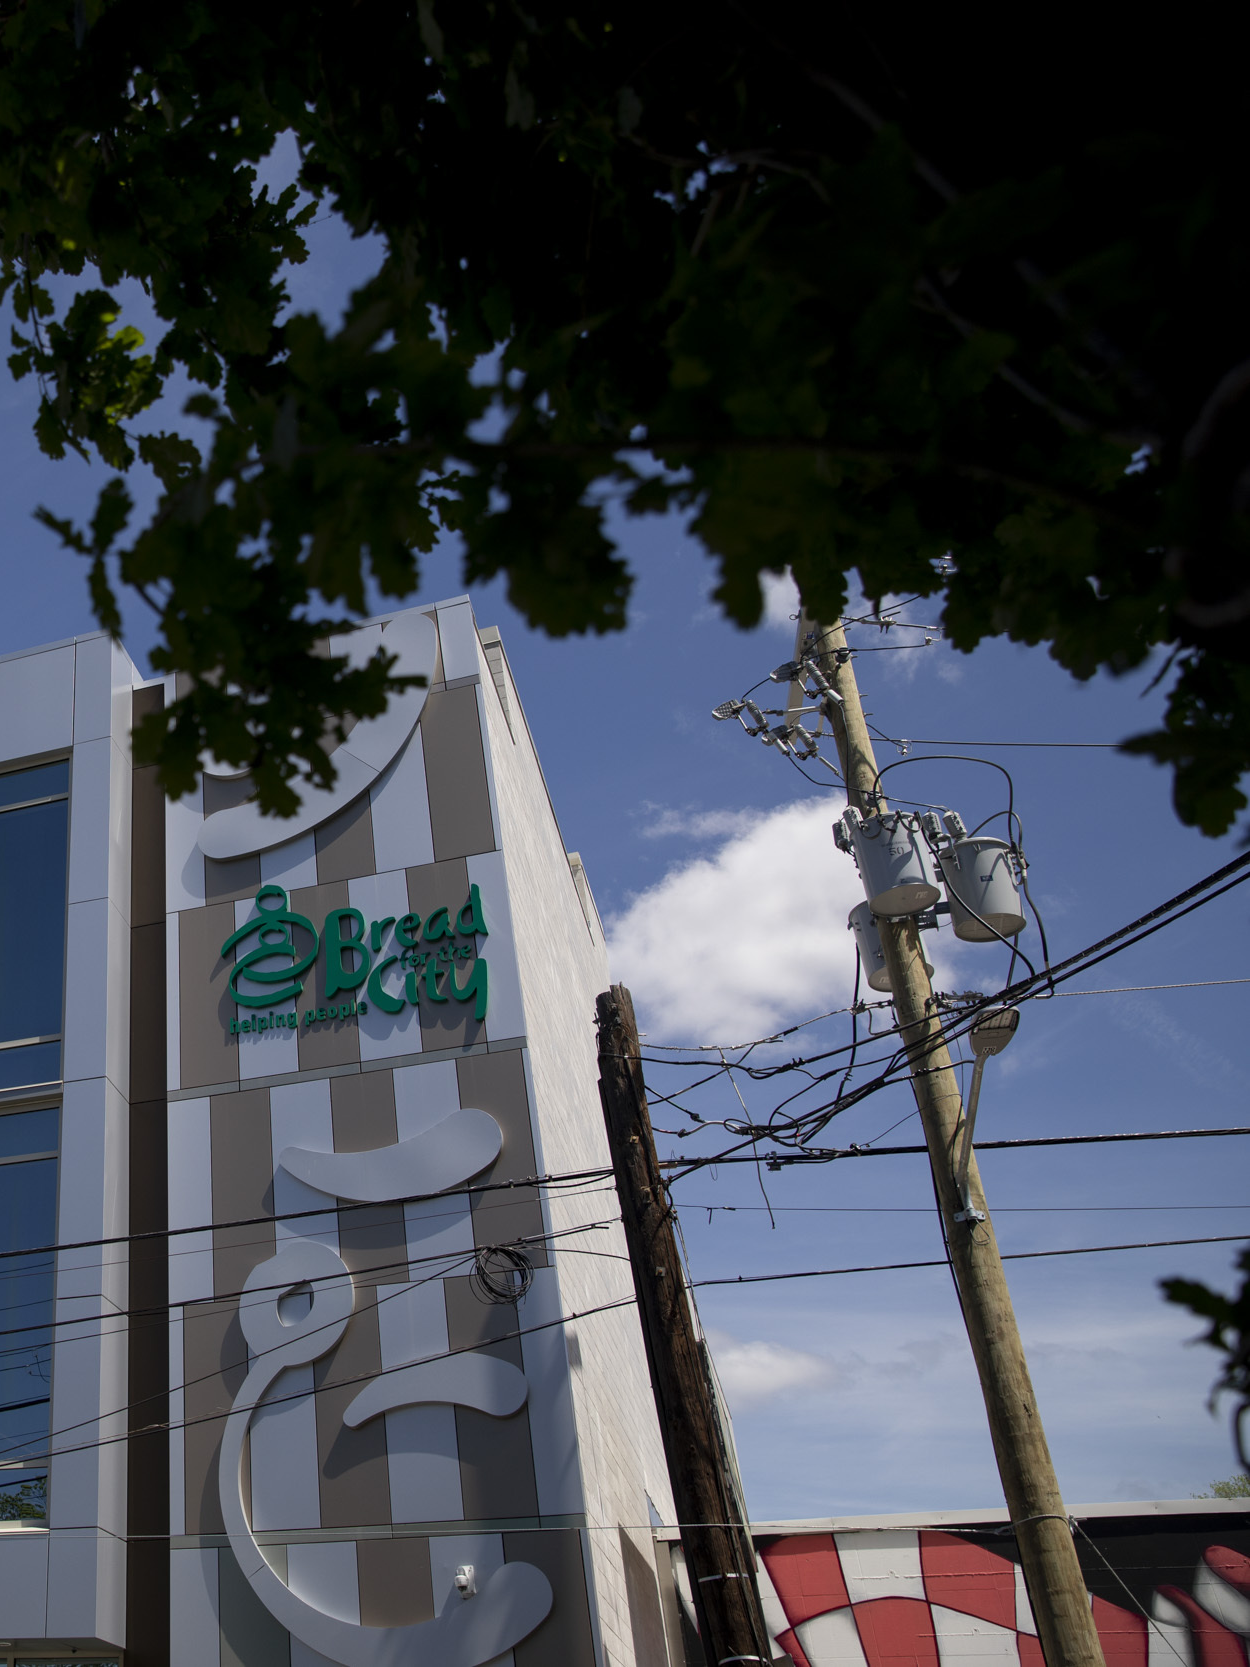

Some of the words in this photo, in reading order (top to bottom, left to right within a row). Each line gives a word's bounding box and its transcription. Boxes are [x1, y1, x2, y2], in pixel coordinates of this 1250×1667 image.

[888, 846, 905, 856] 50
[324, 883, 489, 999] Bread
[399, 948, 431, 970] for
[436, 941, 471, 962] the
[367, 955, 488, 1021] City
[229, 1011, 298, 1034] helping
[304, 999, 368, 1026] people
